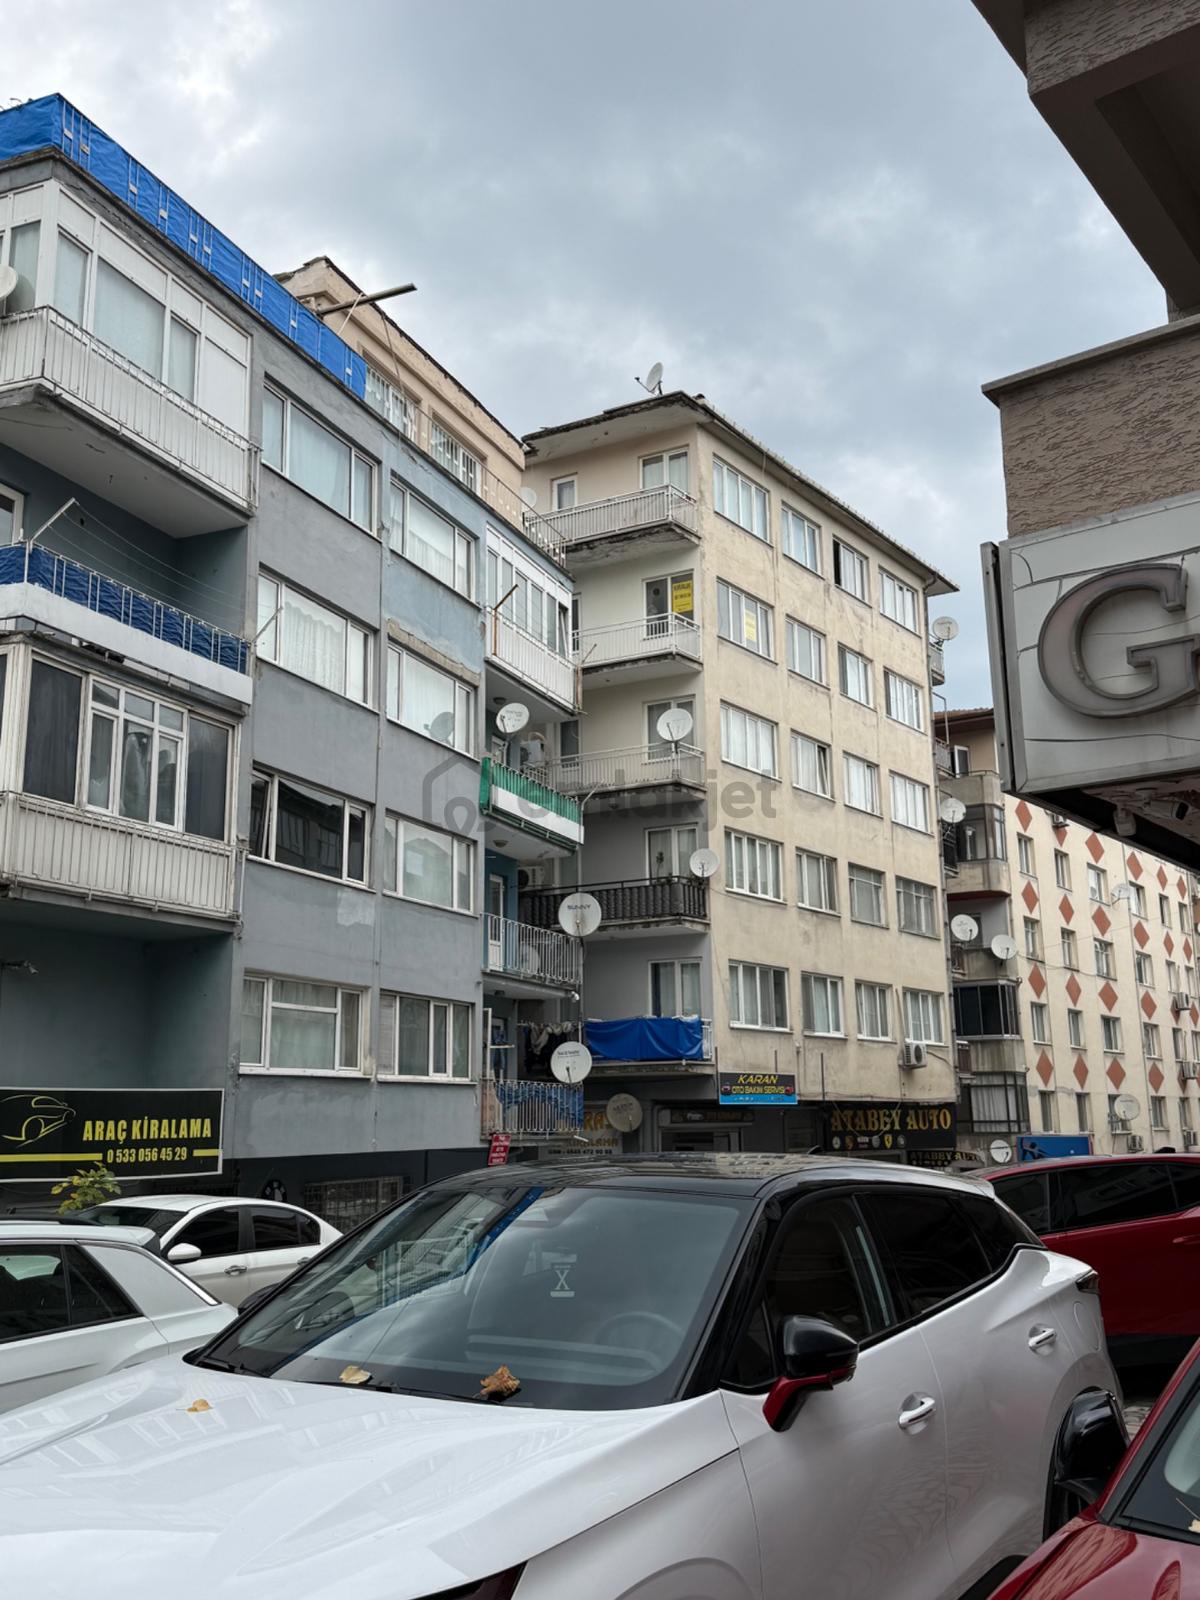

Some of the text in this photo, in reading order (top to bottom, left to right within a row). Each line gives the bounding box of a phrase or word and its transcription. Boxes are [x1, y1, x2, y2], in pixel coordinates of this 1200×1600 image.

[737, 1072, 779, 1084] KARAN
[731, 1085, 745, 1094] OTO
[831, 1107, 952, 1132] ATABEY AUTO
[83, 1116, 212, 1144] ARAÇ KİRALAMA
[106, 1146, 188, 1163] 0 533 056 45 29
